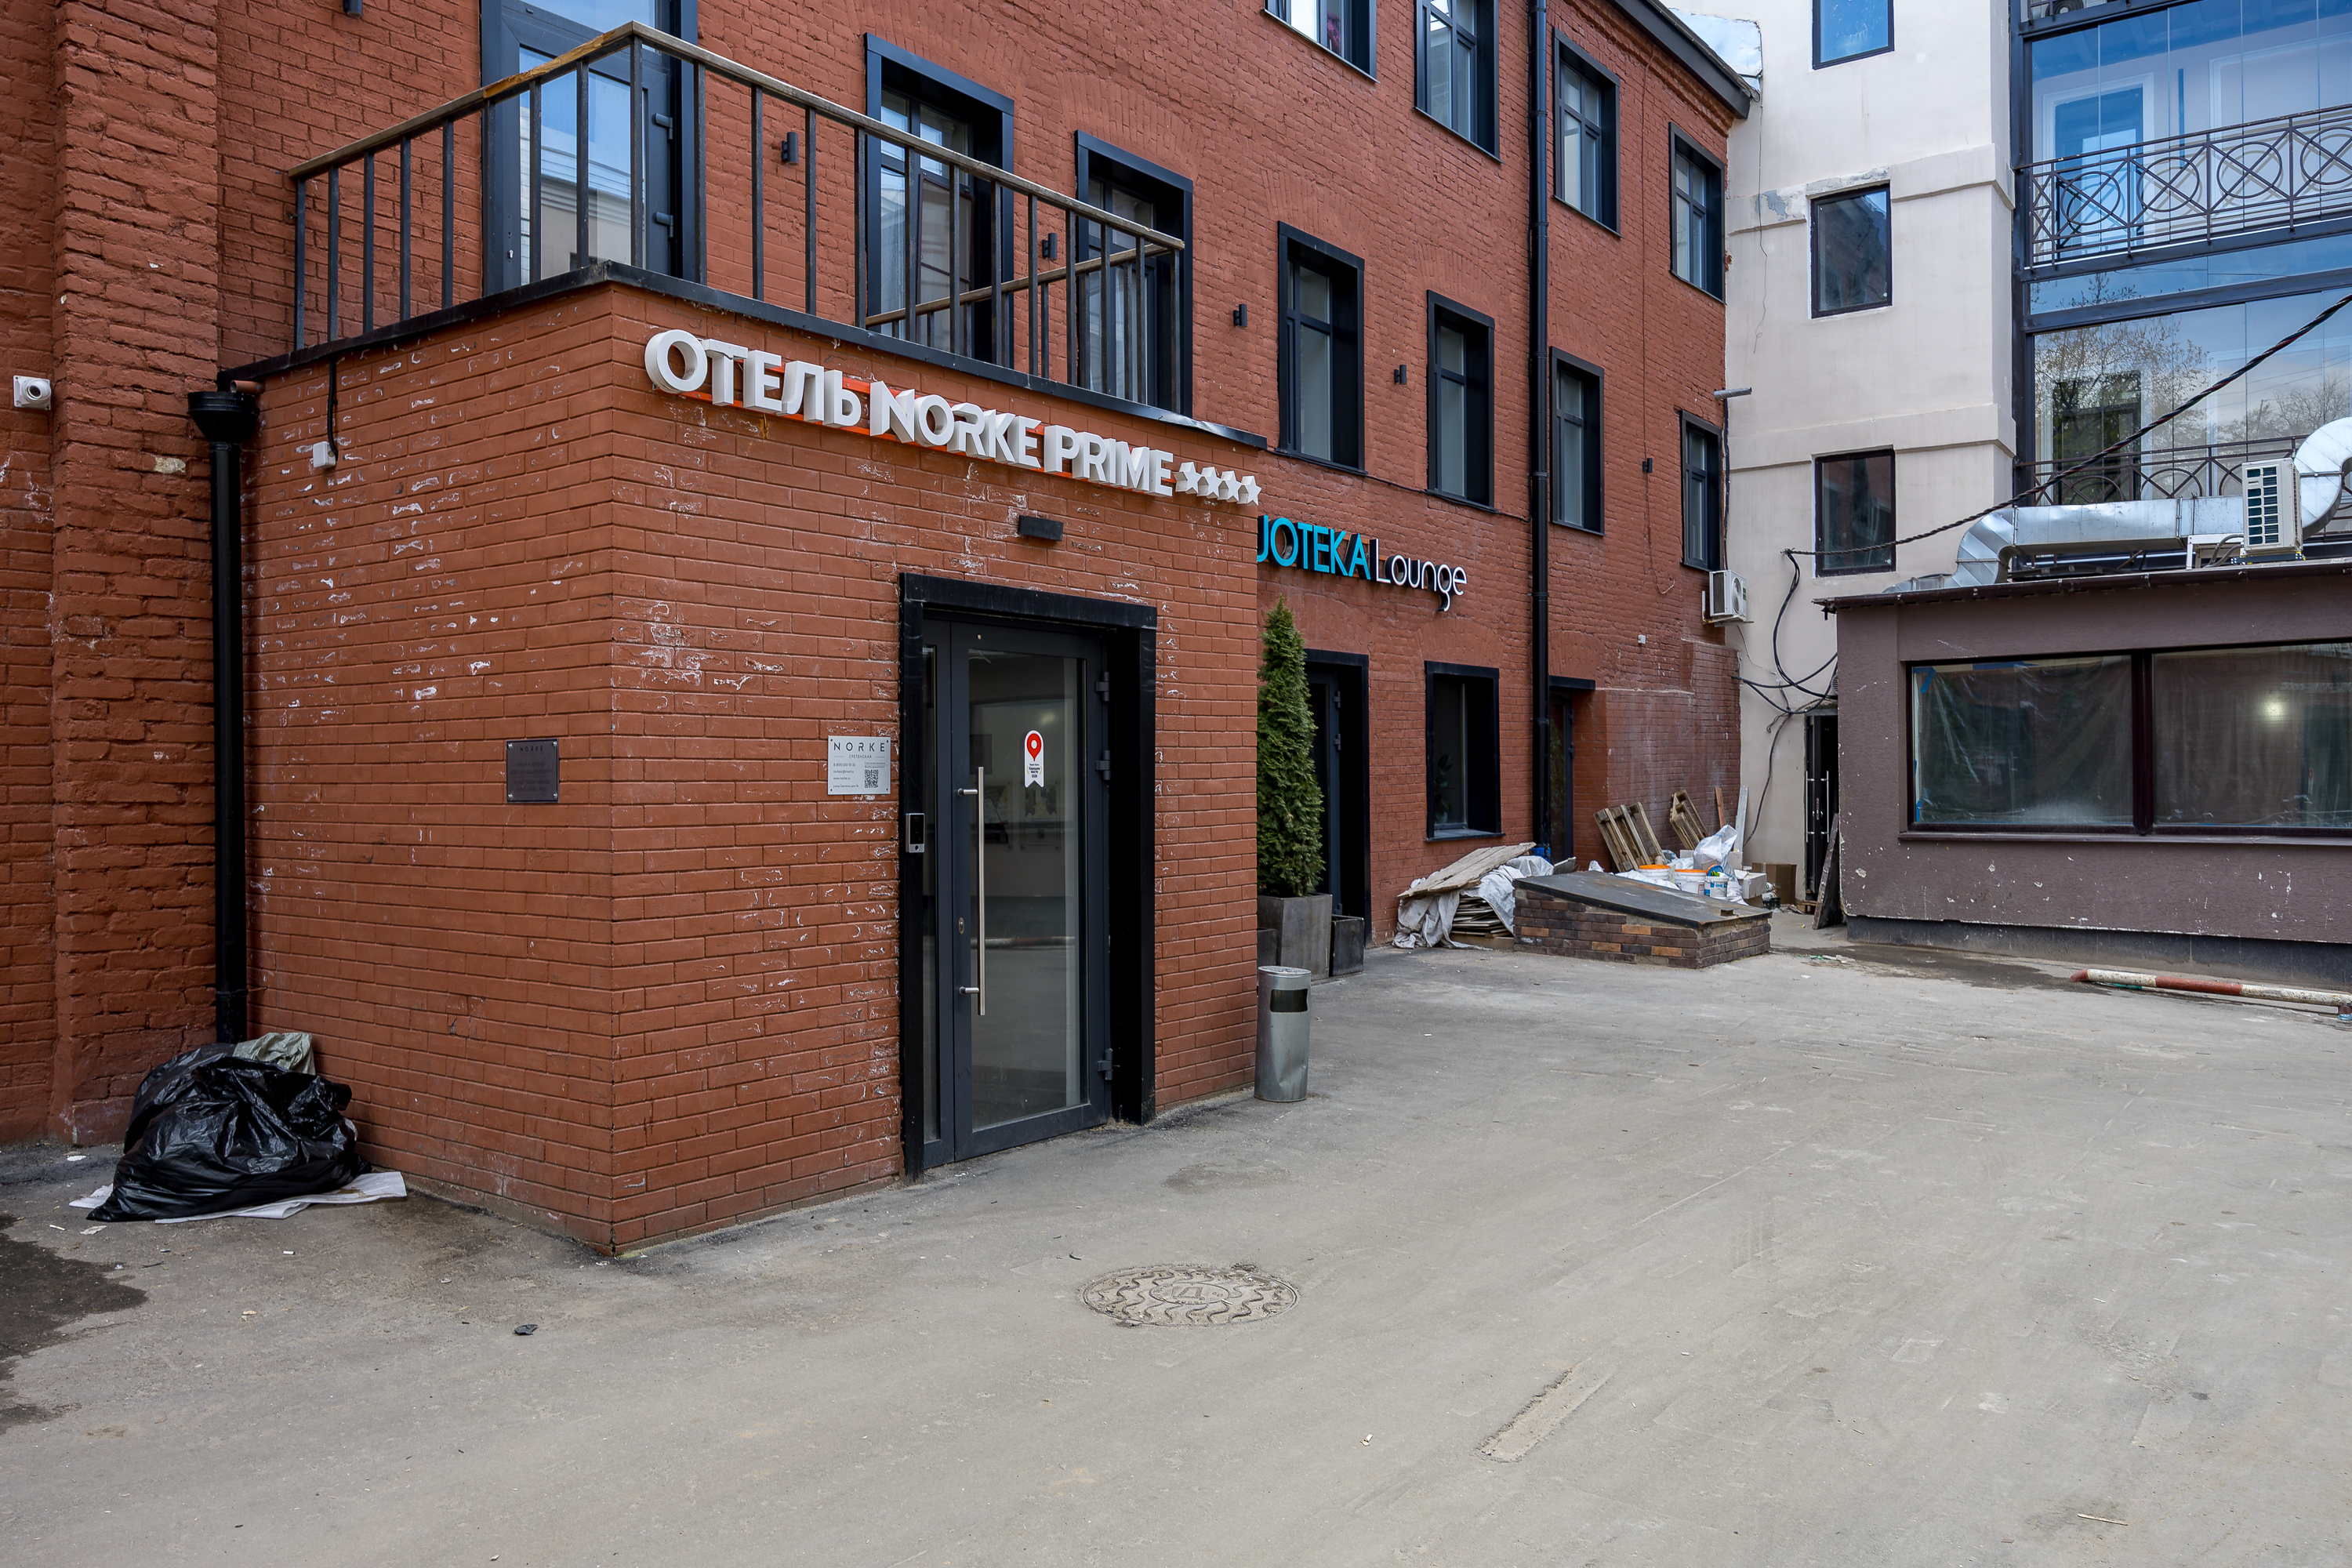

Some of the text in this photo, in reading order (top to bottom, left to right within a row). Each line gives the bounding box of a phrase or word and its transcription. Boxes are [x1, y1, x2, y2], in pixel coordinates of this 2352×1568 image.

[644, 329, 1174, 497] ОТЕЛЬ NORKE PRIME
[1372, 538, 1468, 612] Lounge
[833, 742, 885, 752] NORKE
